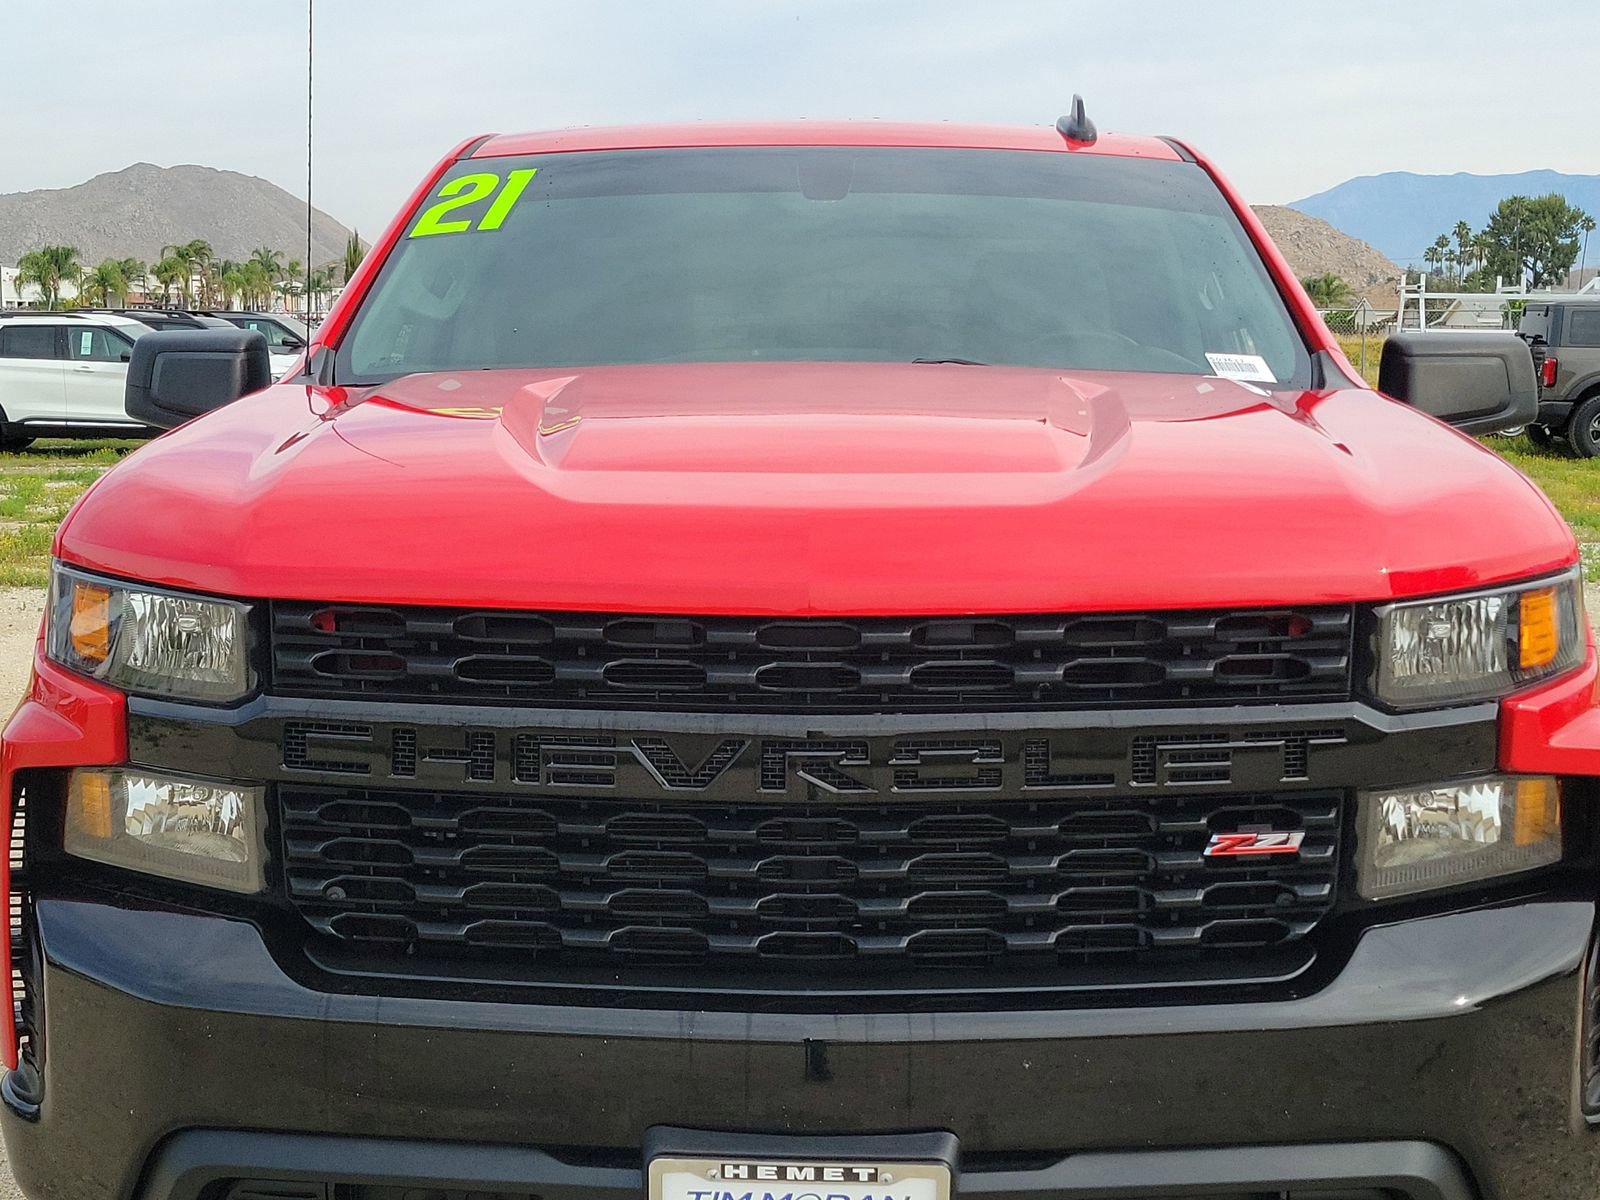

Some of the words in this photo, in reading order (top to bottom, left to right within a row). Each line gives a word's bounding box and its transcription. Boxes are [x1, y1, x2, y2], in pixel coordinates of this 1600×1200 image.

[409, 168, 537, 238] 21
[280, 721, 1348, 793] CHEVROLET
[724, 1165, 876, 1182] HEMET
